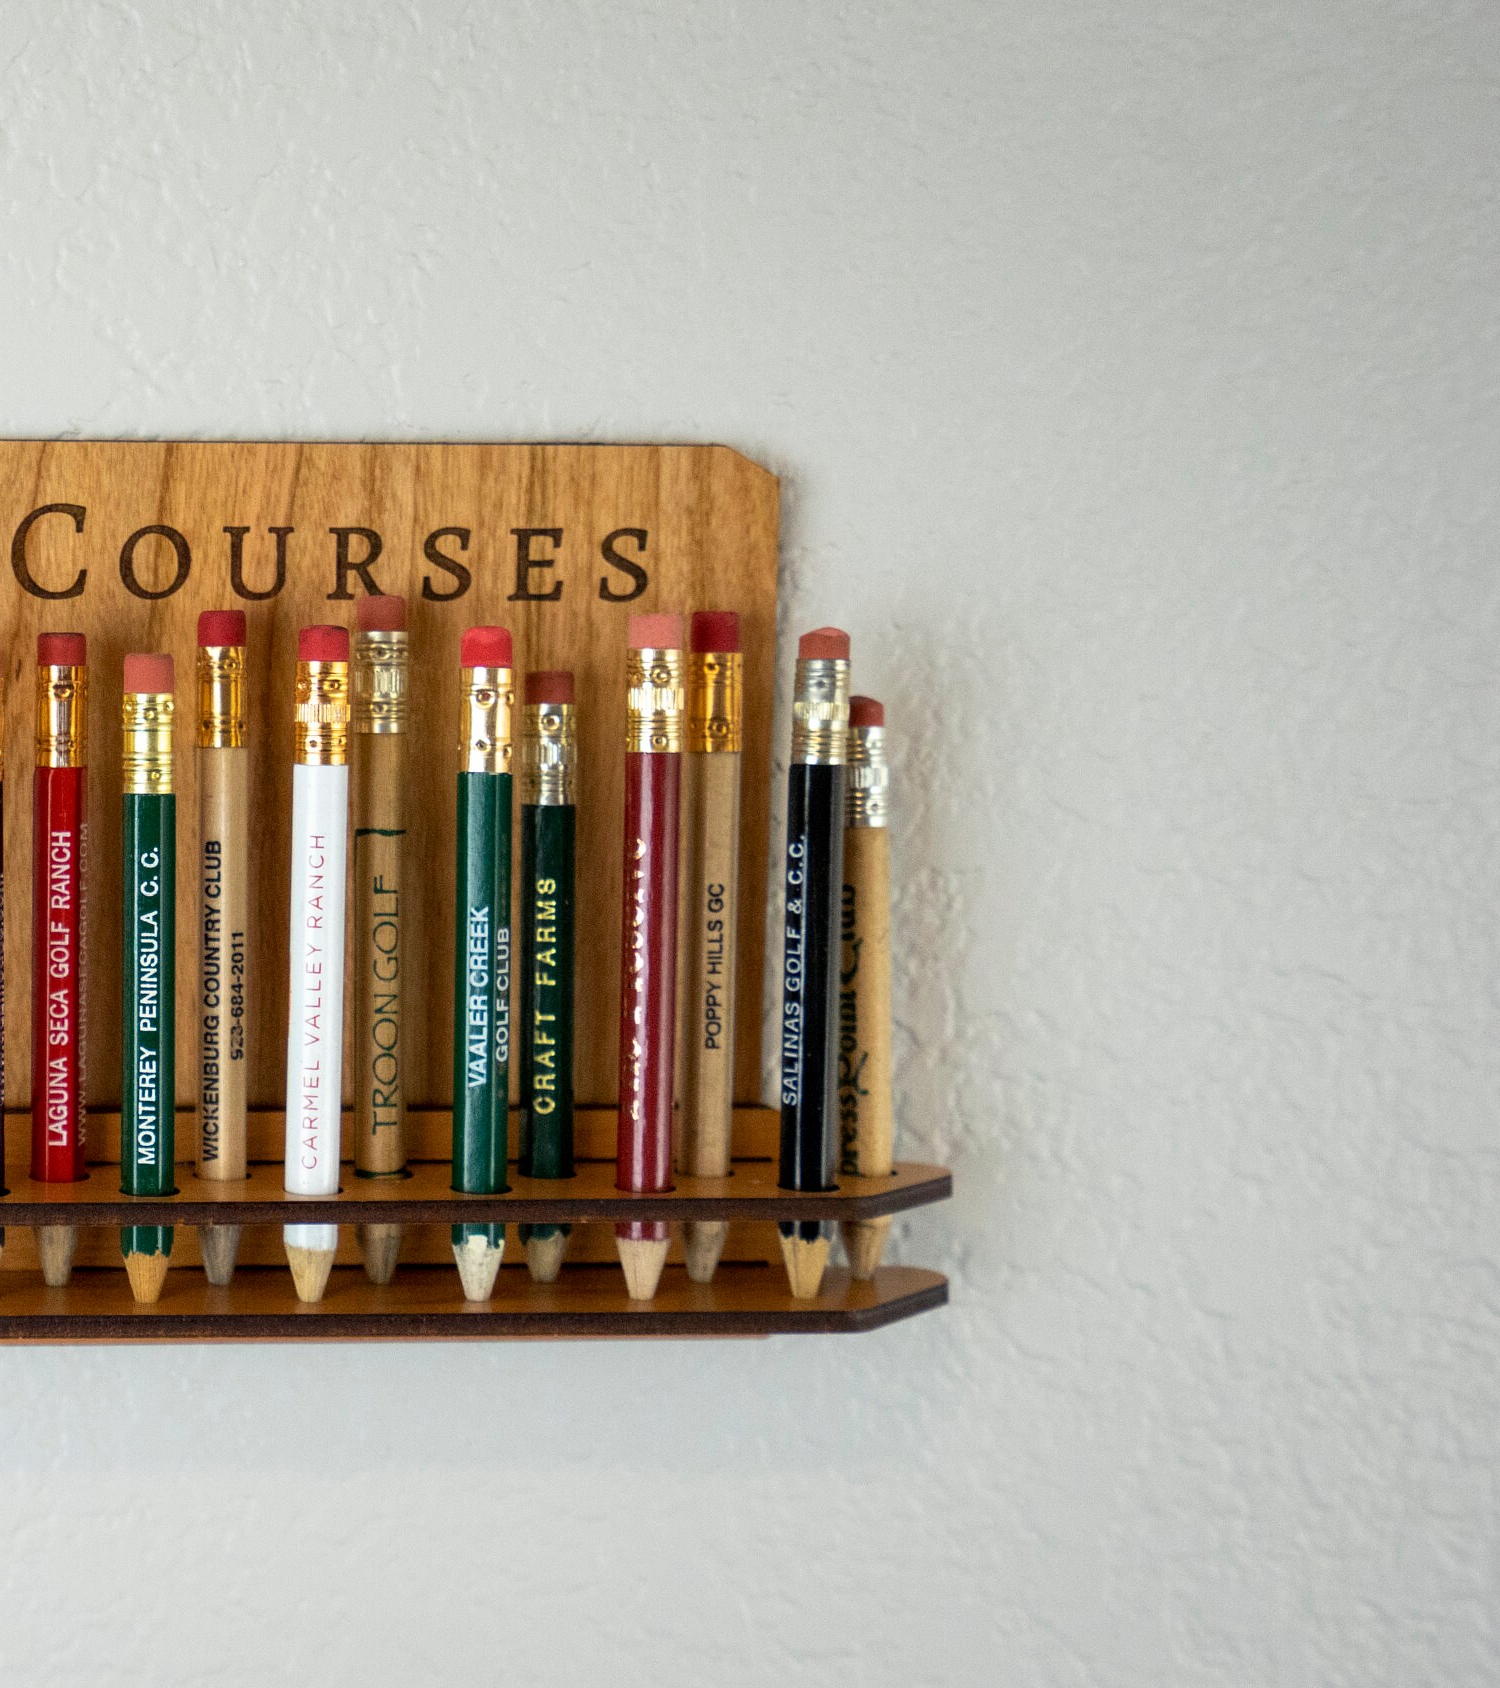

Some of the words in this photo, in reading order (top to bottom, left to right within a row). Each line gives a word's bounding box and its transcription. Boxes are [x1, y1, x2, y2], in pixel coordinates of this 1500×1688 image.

[11, 503, 653, 602] COURSES
[52, 832, 71, 909] RANCH
[204, 840, 222, 898] CLUB
[308, 835, 325, 929] RANCH
[708, 883, 725, 913] GC
[788, 834, 805, 884] C.C.
[51, 922, 70, 978] GOLF
[373, 875, 399, 981] GOLF
[470, 906, 489, 987] CREEK
[536, 878, 556, 985] FARMS
[706, 920, 723, 974] HILLS
[787, 900, 803, 914] &
[78, 823, 88, 1145] WWW.LAGUNASECAGOLF.COM
[140, 911, 159, 1031] PENINSULA
[204, 904, 220, 1008] COUNTRY
[305, 944, 322, 1045] VALLEY
[496, 928, 509, 991] CLUB
[785, 928, 803, 991] GOLF
[50, 989, 69, 1045] SECA
[469, 995, 488, 1087] VAALER
[496, 1000, 509, 1062] GOLF
[705, 981, 723, 1049] POPPY
[782, 1002, 801, 1106] SALINAS
[49, 1057, 68, 1146] LAGUNA
[138, 1047, 157, 1164] MONTEREY
[203, 1015, 220, 1161] WICKENBURG
[371, 994, 399, 1135] TROON
[534, 1011, 556, 1114] CRAFT
[301, 1060, 320, 1169] CARMEL
